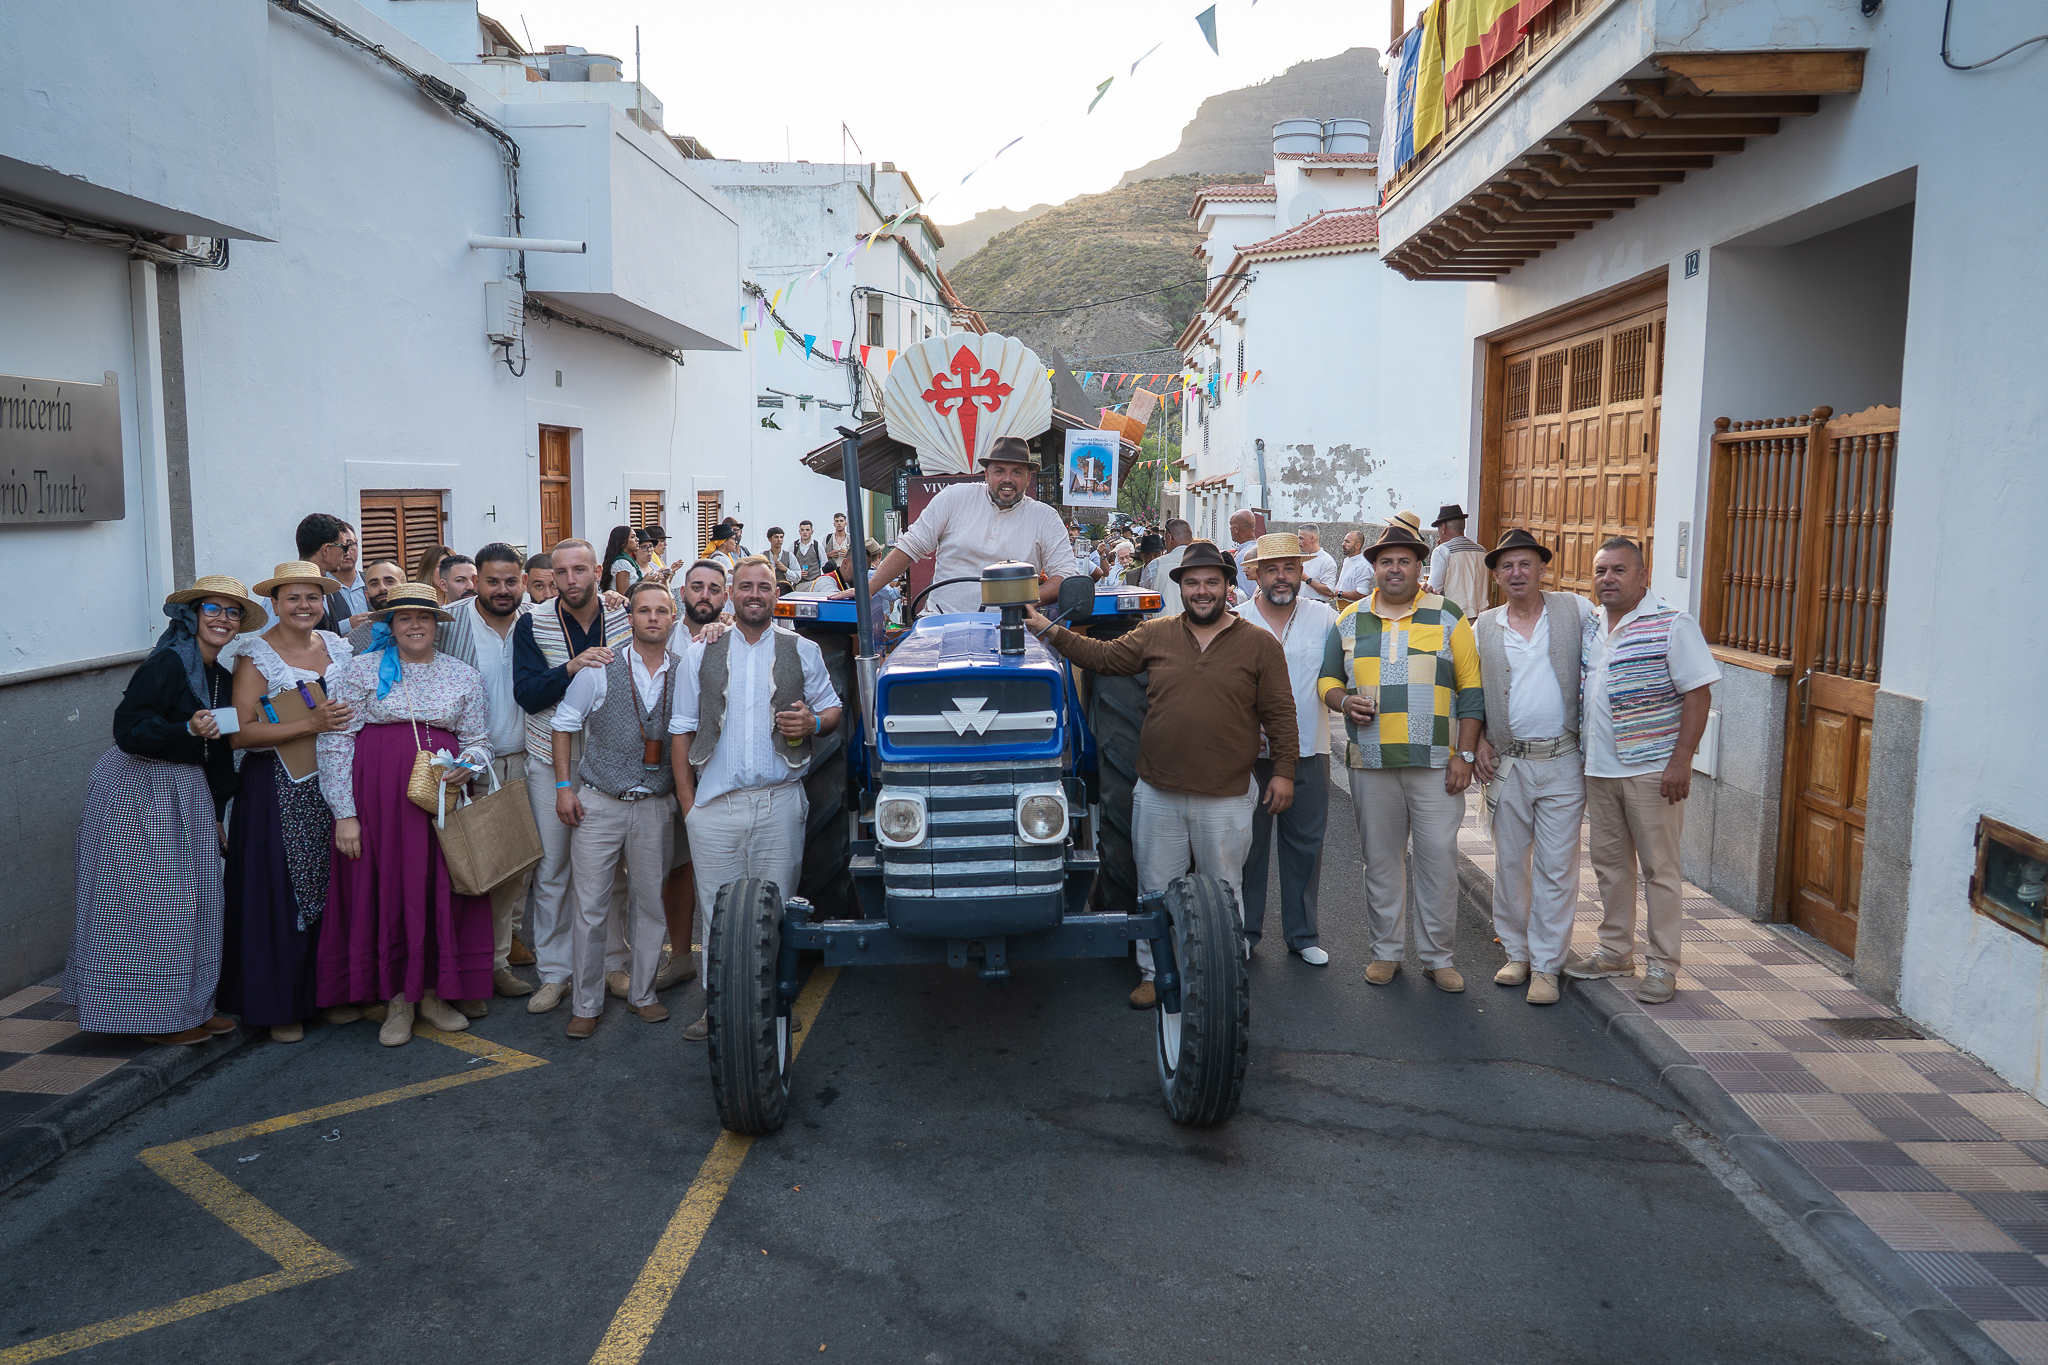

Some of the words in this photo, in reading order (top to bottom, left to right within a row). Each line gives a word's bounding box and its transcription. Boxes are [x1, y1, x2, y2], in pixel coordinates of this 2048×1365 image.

[1688, 254, 1697, 275] 12
[1085, 457, 1097, 480] 1
[33, 470, 87, 514] Tunte
[923, 483, 950, 493] VIV
